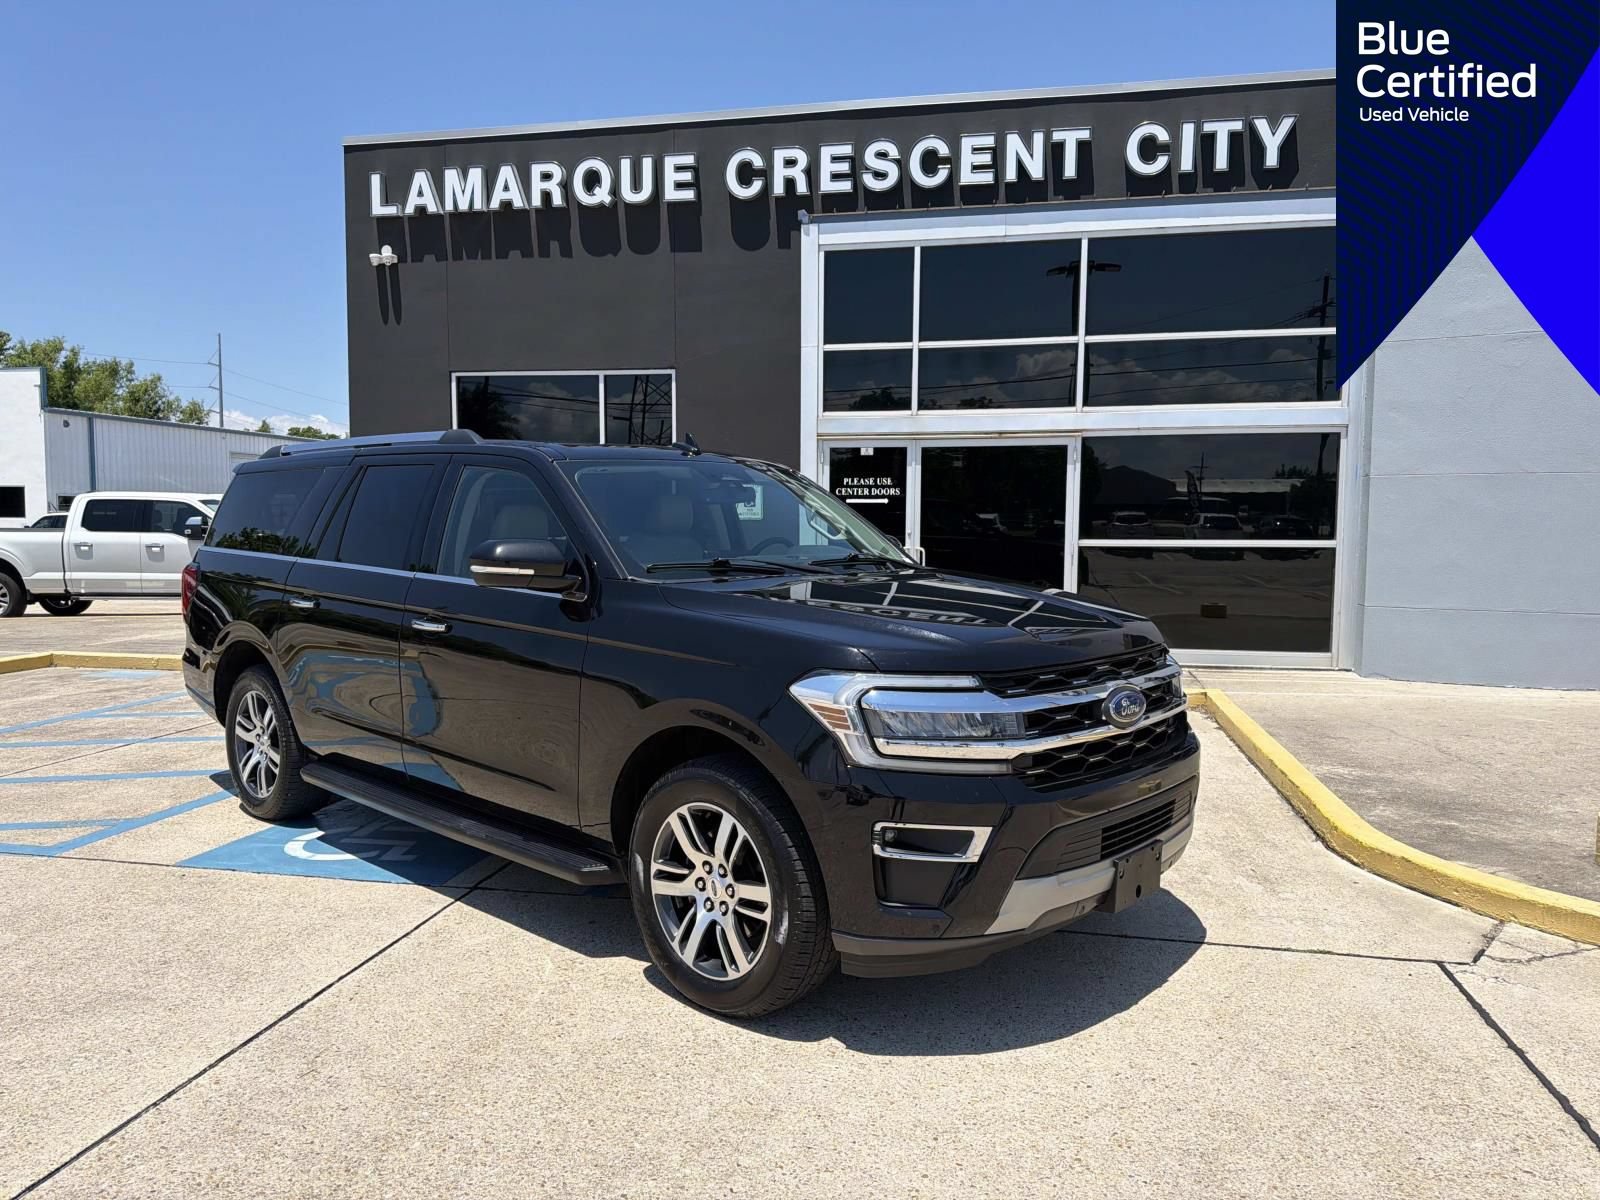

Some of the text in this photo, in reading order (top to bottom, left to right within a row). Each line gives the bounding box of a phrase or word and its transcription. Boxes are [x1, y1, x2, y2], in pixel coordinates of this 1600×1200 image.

[370, 115, 1297, 216] LAMARQUE CRESCENT CITY
[843, 477, 893, 486] PLEASE USE
[835, 487, 901, 496] CENTER DOORS
